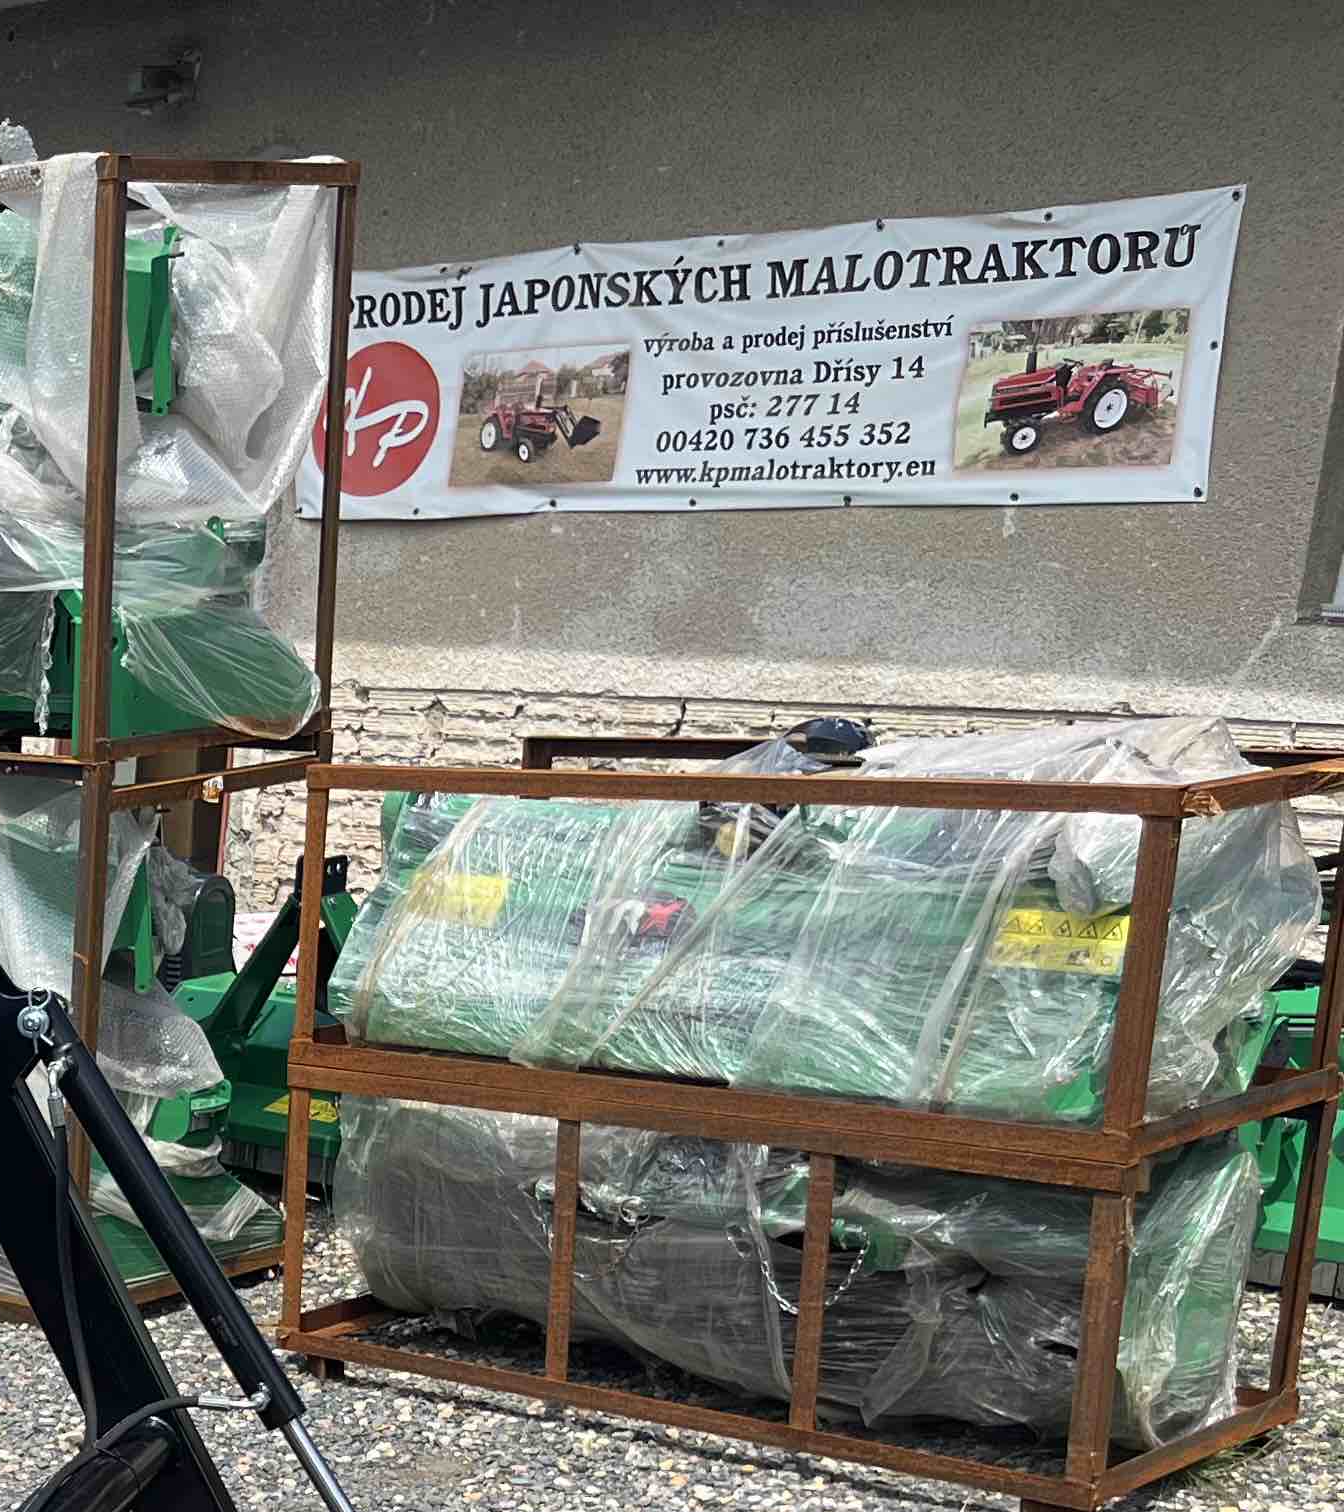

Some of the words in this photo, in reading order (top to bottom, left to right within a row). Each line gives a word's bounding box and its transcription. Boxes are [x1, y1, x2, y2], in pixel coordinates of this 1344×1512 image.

[350, 284, 466, 330] RODEJ
[476, 256, 752, 328] JAPONSKÝCH
[765, 223, 1202, 299] MALOTRAKTORŮ
[643, 331, 714, 357] výroba
[722, 334, 734, 351] a
[741, 324, 805, 353] prodej
[813, 314, 955, 349] příslušenství
[662, 367, 803, 396] provozovna
[812, 358, 881, 387] Dřísy
[890, 355, 925, 380] 14
[709, 395, 757, 425] psč:
[765, 393, 820, 418] 277
[827, 391, 861, 415] 14
[655, 428, 734, 453] 00420
[744, 426, 790, 450] 736
[799, 423, 850, 448] 455
[859, 421, 912, 446] 352
[635, 456, 936, 488] www.kpmalotraktory.eu
